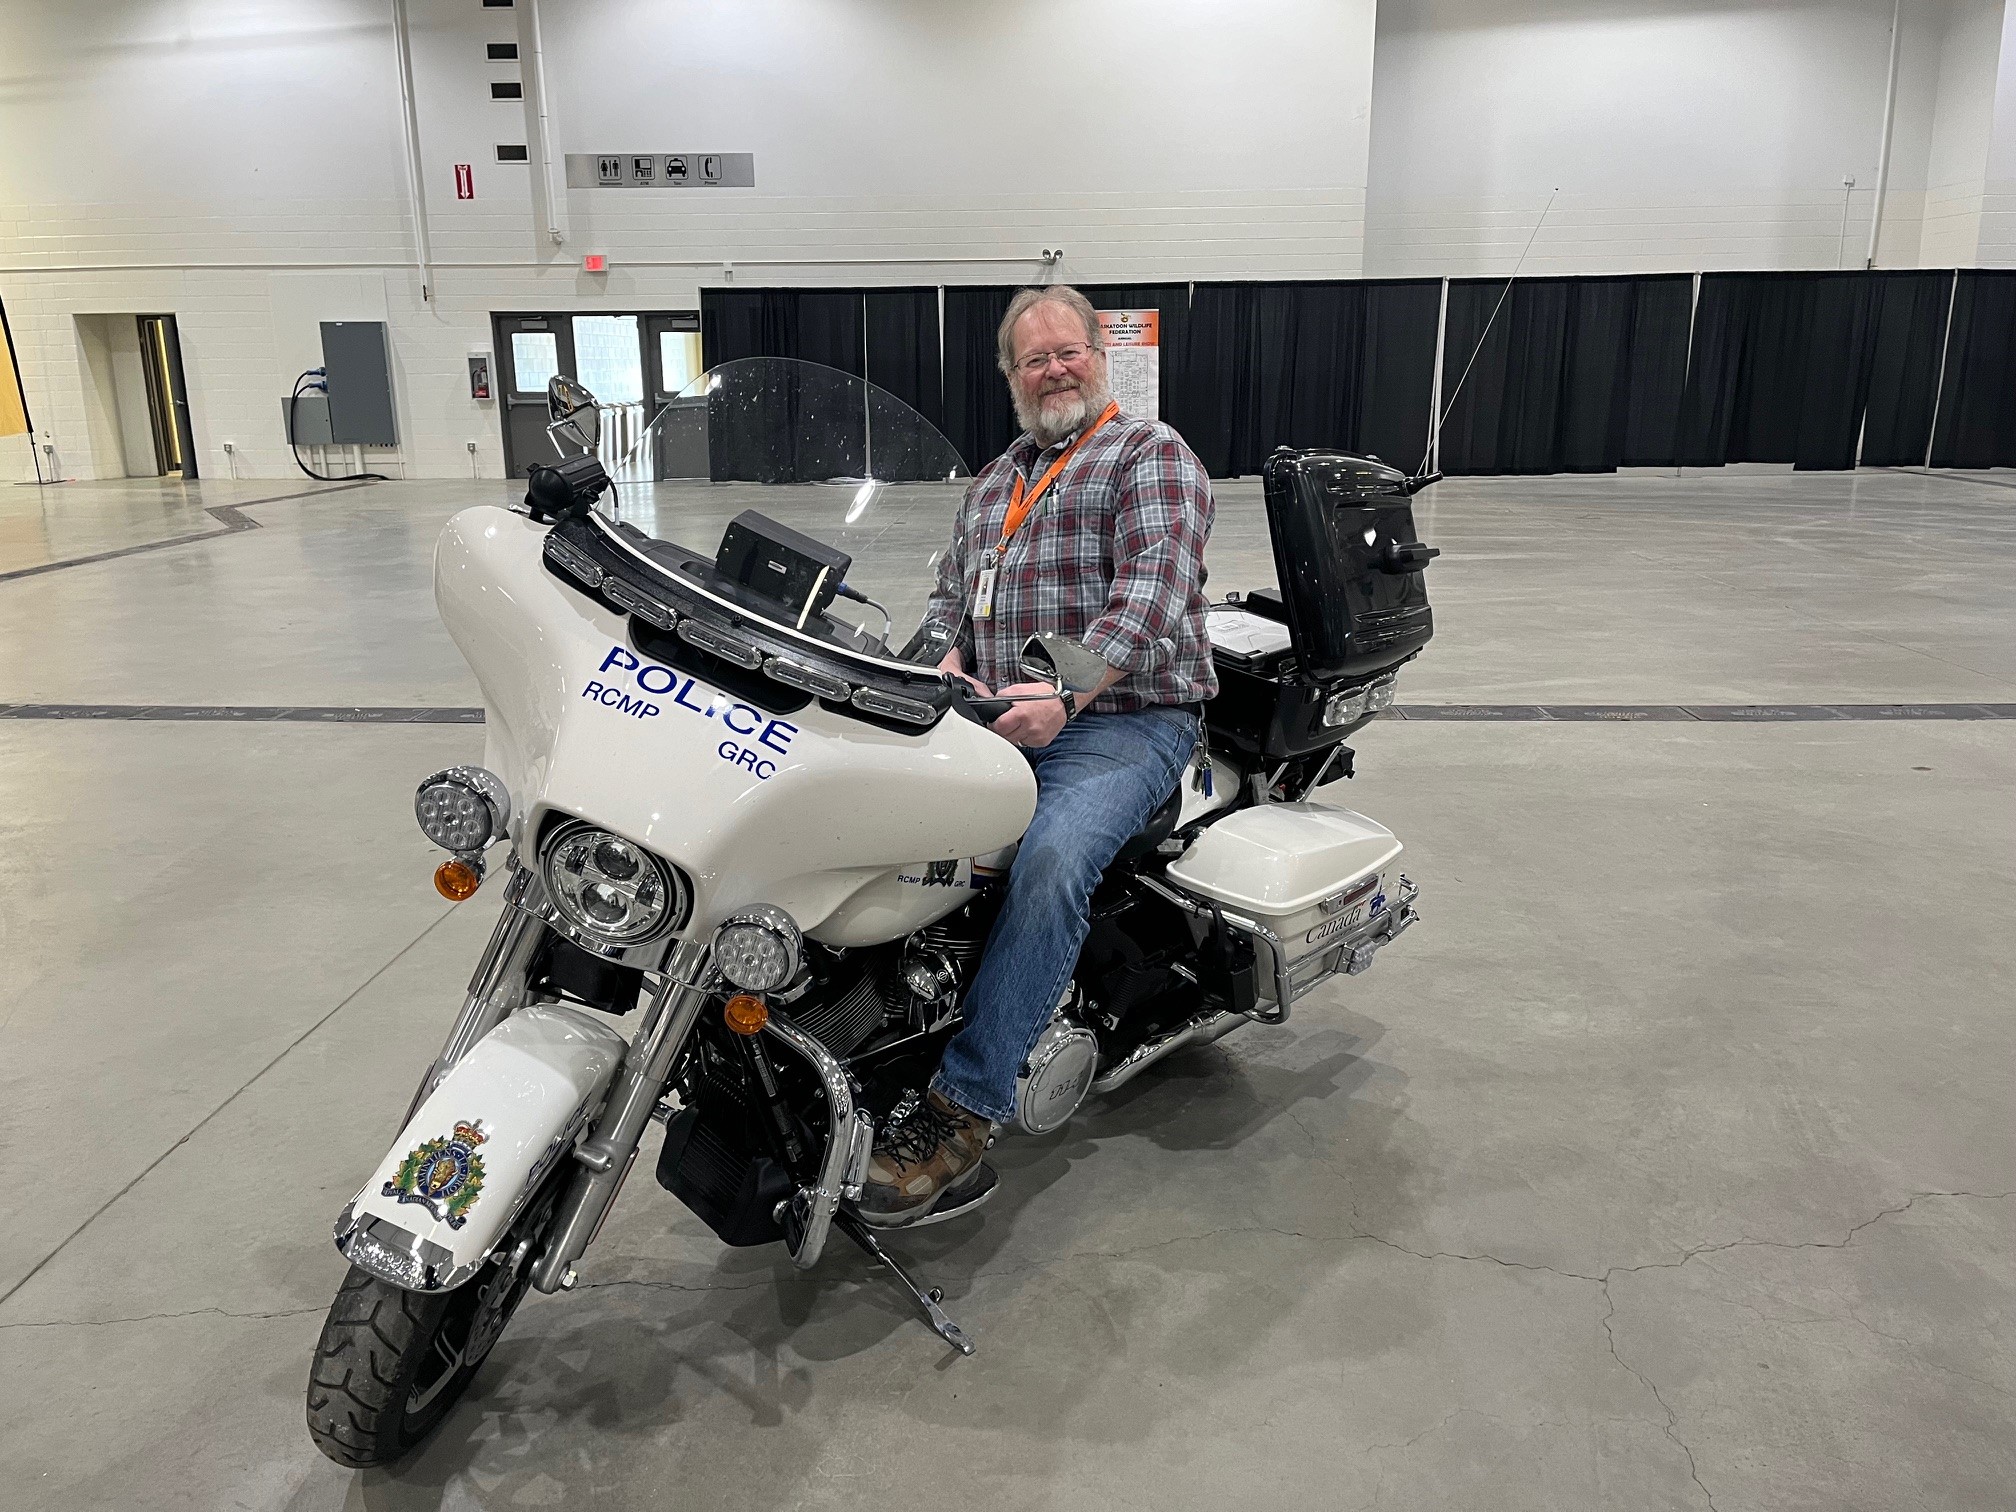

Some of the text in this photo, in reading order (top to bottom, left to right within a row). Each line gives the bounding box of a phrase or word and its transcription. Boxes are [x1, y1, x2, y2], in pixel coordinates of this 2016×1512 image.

[582, 681, 660, 719] RCMP
[599, 646, 799, 755] POLICE
[718, 741, 776, 780] GRC
[897, 875, 921, 884] RCMP
[1306, 905, 1362, 943] Canada
